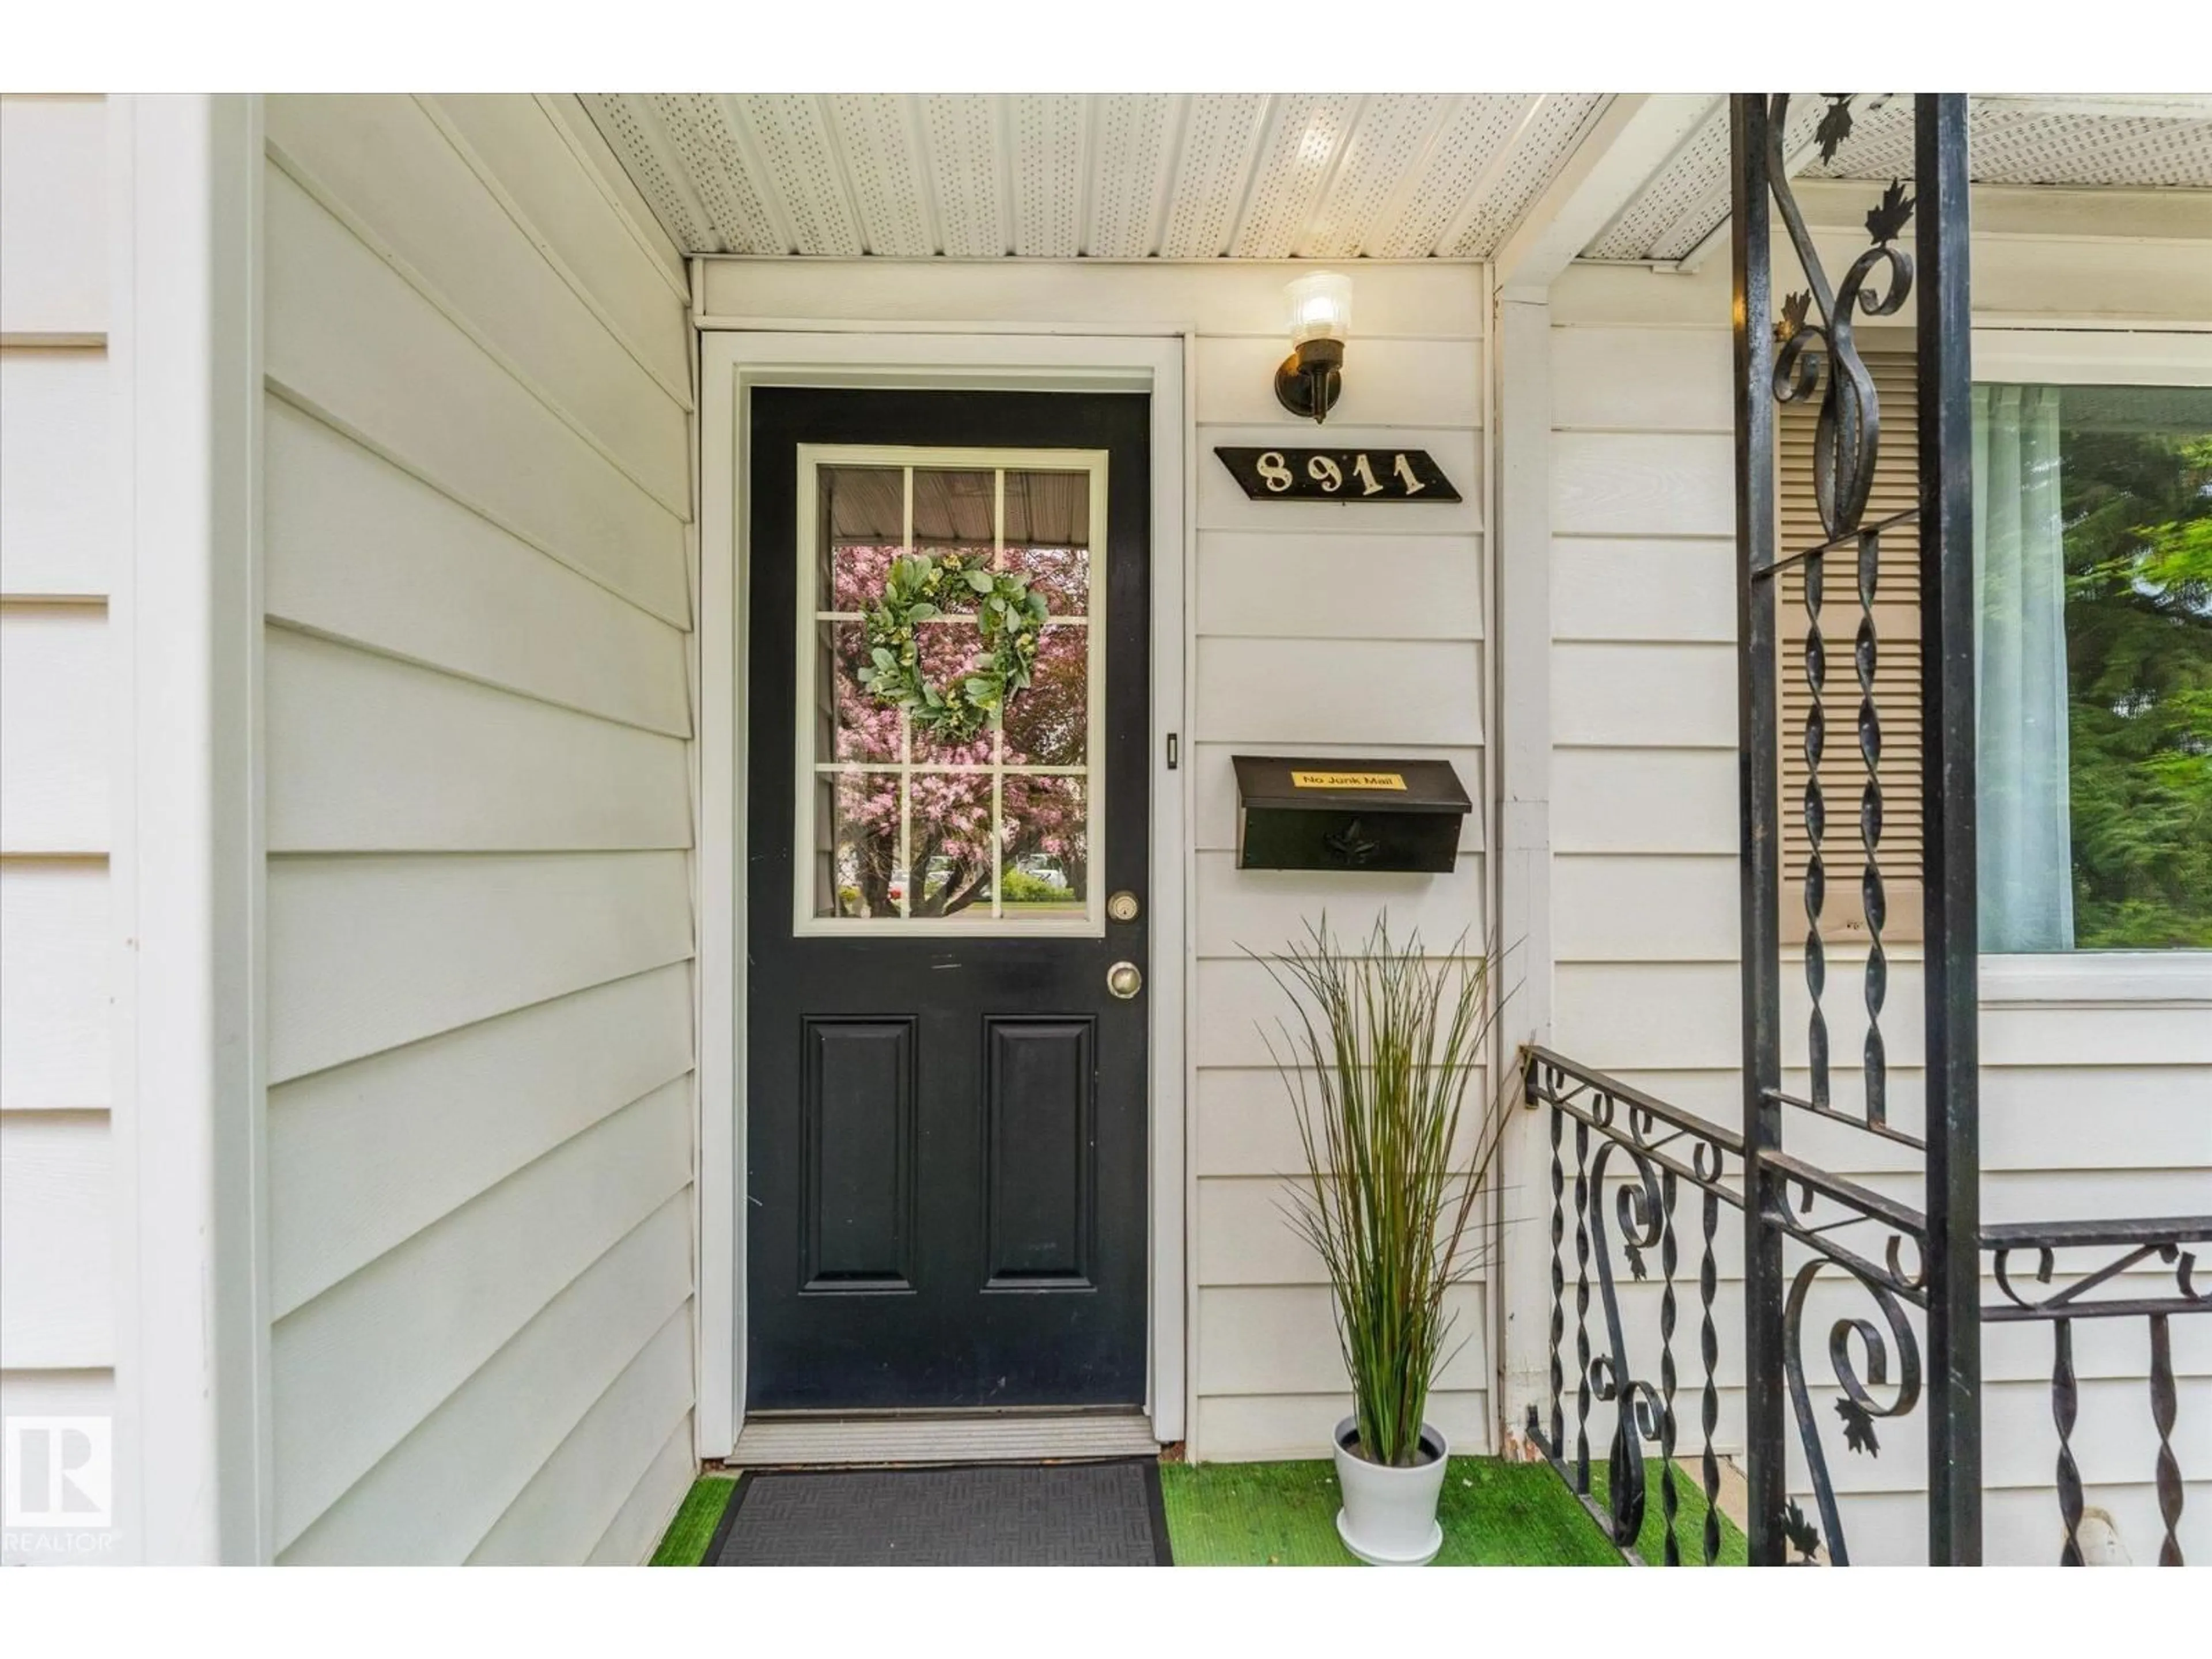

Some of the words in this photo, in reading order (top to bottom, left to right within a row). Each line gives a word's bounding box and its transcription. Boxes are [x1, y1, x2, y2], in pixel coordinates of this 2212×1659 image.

[1256, 452, 1426, 495] 8911
[1304, 775, 1325, 785] No
[1328, 777, 1362, 785] Junk
[1364, 778, 1394, 786] Mail
